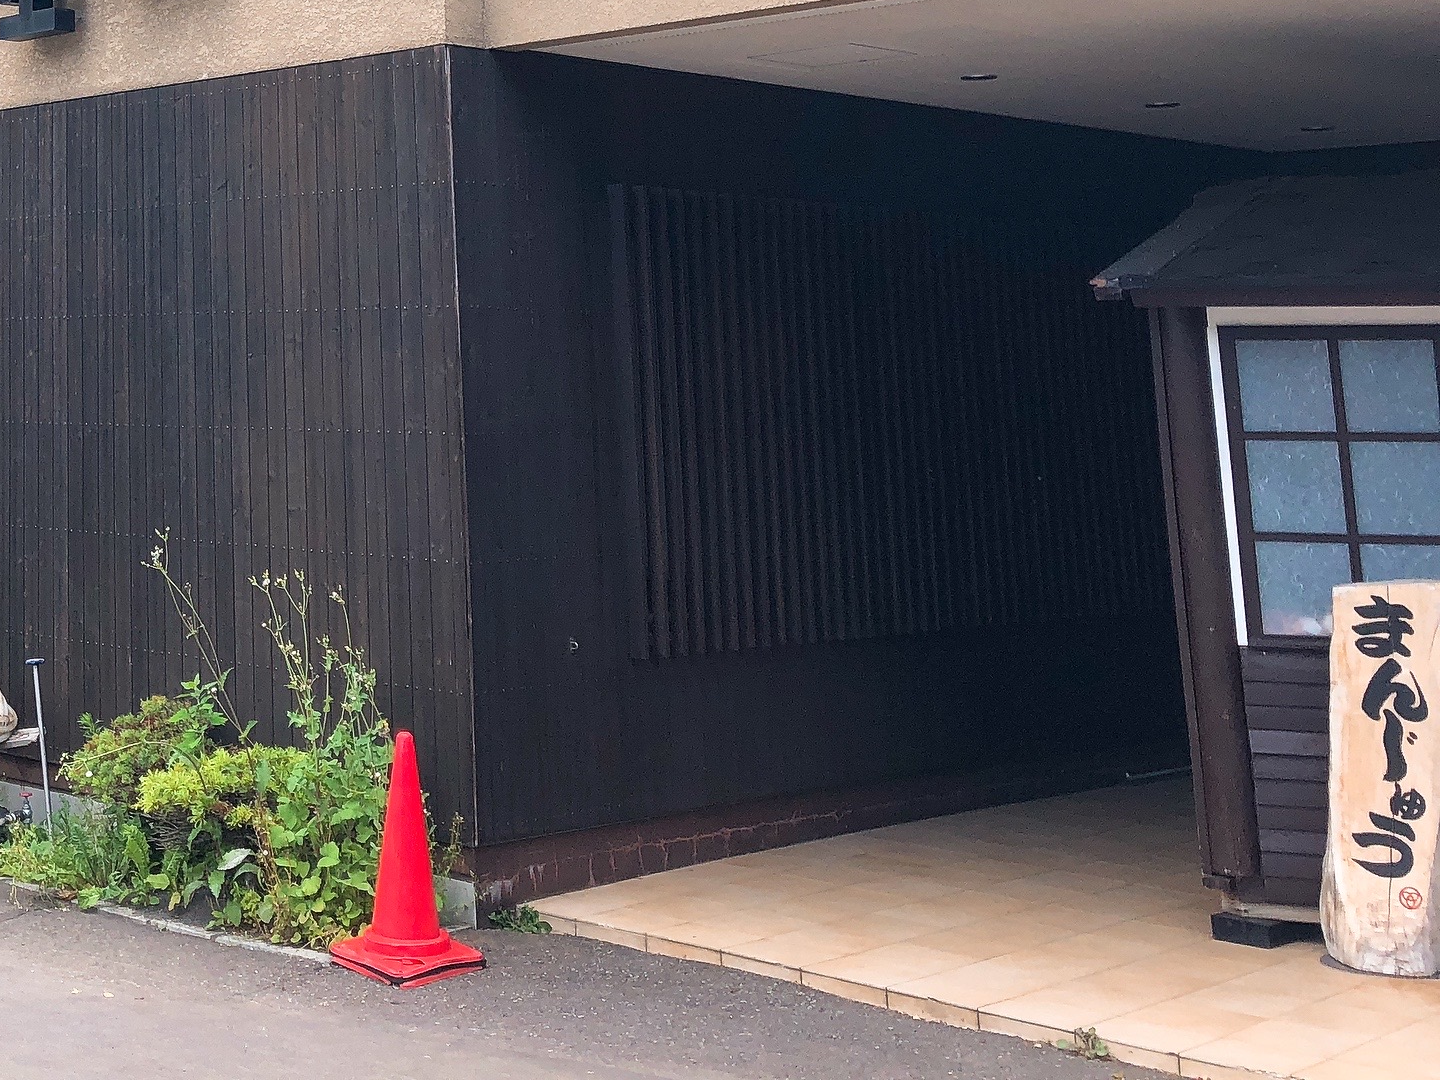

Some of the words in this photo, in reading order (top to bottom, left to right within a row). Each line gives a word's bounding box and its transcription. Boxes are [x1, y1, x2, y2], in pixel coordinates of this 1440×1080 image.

[1351, 594, 1429, 879] まんじゅう
